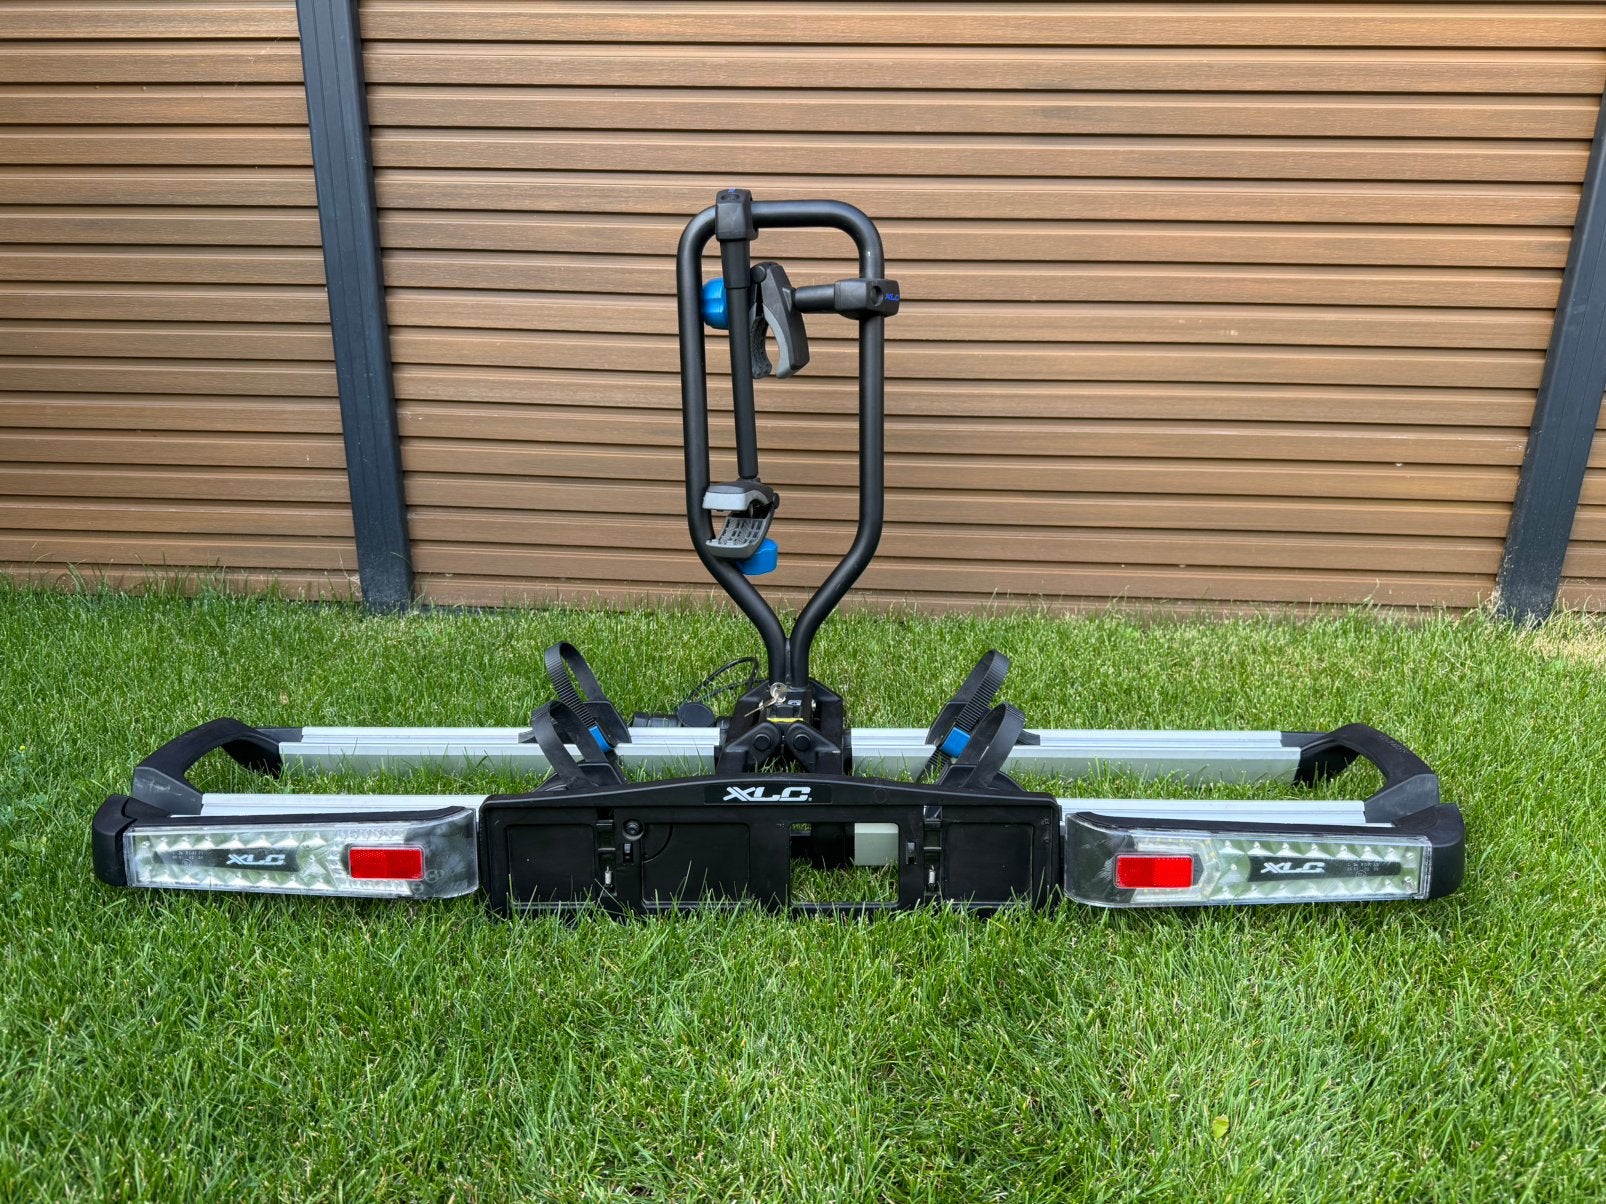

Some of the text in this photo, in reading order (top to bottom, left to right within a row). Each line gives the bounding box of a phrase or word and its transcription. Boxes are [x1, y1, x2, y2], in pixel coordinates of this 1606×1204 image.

[724, 787, 812, 801] XLC
[227, 855, 286, 865] XLC
[1261, 862, 1326, 873] XLC
